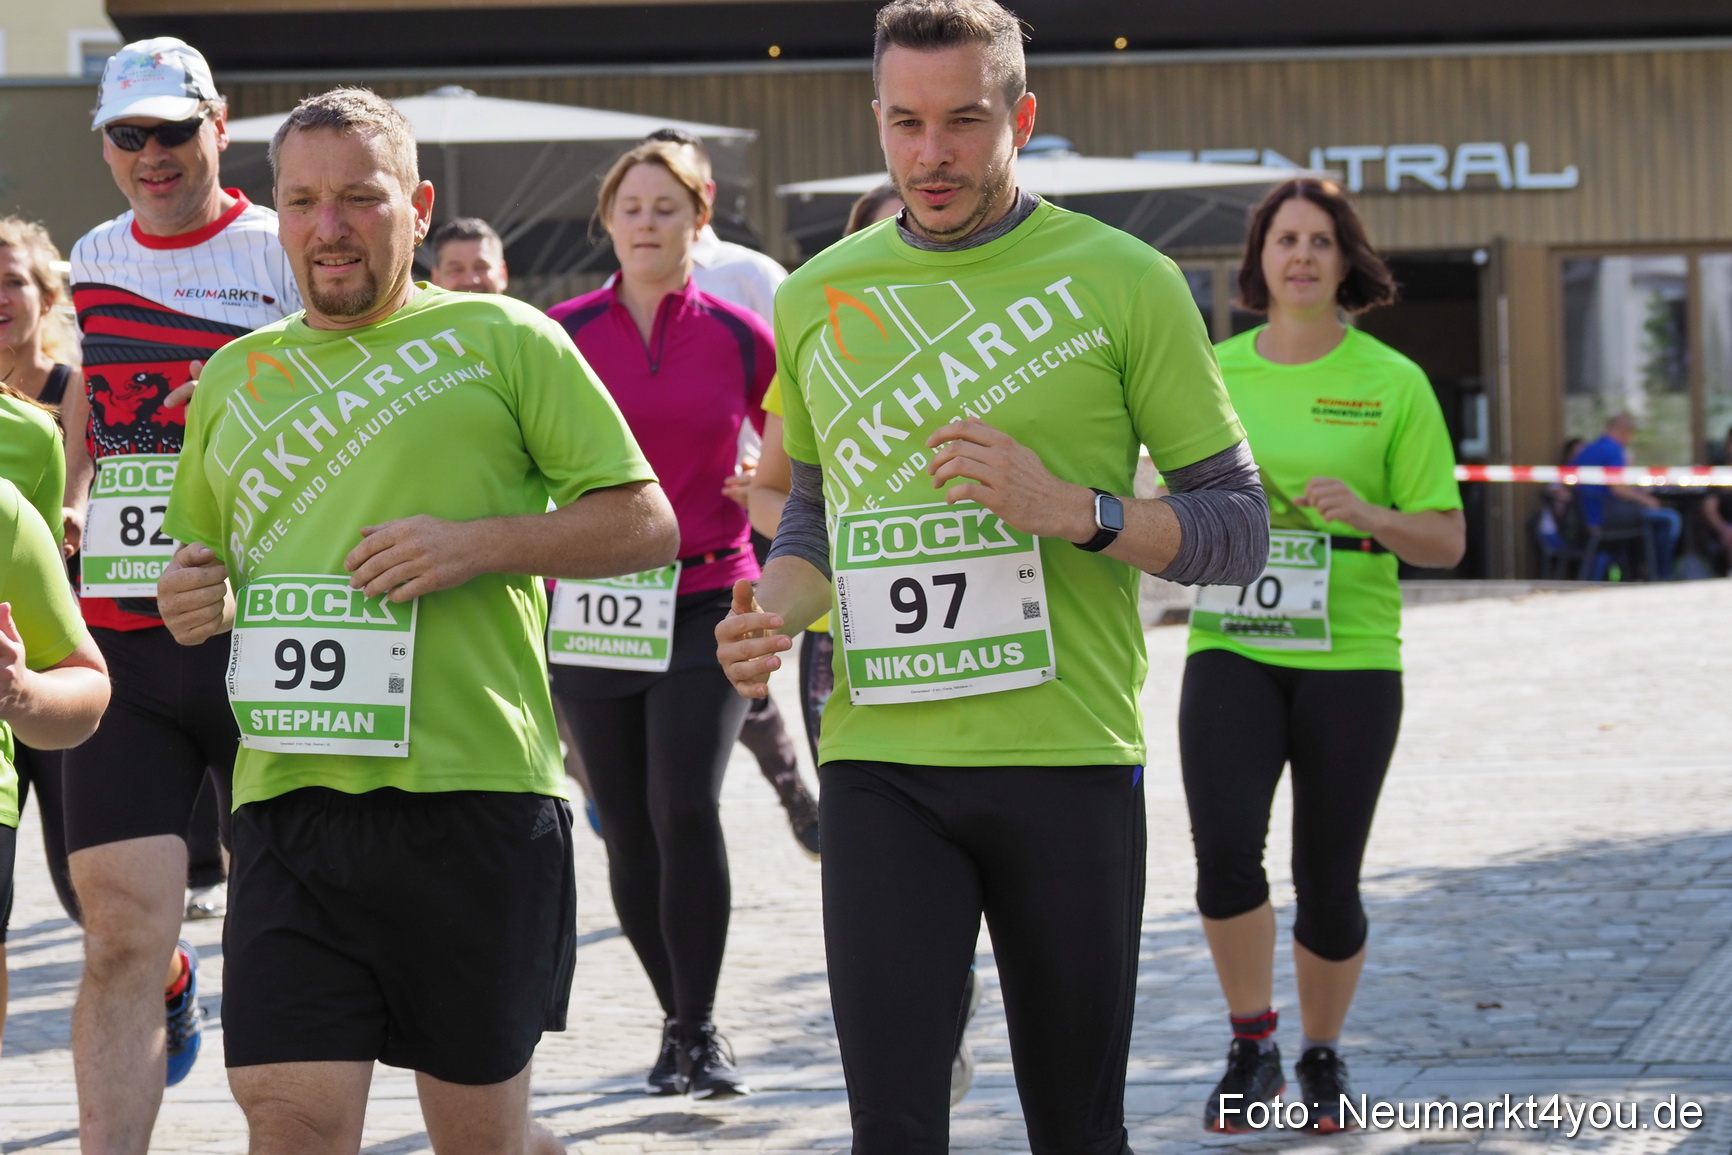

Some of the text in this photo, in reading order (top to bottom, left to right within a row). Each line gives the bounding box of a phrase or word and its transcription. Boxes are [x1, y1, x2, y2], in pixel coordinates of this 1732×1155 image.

[1134, 142, 1578, 191] TRAL
[174, 288, 259, 302] NEUMARKT
[886, 327, 1111, 493] UND ÄUDETECHNIK
[291, 475, 327, 515] UND
[326, 360, 492, 478] GEBÄUDETECHNIK
[97, 461, 178, 494] BOC
[120, 505, 174, 547] 82
[847, 508, 1019, 562] BOCK
[105, 558, 168, 580] JÜRG
[1019, 568, 1034, 579] E6
[244, 583, 398, 625] BOCK
[576, 592, 643, 629] 102
[890, 572, 967, 634] 97
[274, 638, 346, 691] 99
[391, 647, 406, 656] E6
[563, 634, 654, 657] JOHANNA
[865, 641, 1025, 681] NIKOLAUS
[250, 708, 375, 734] STEPHAN
